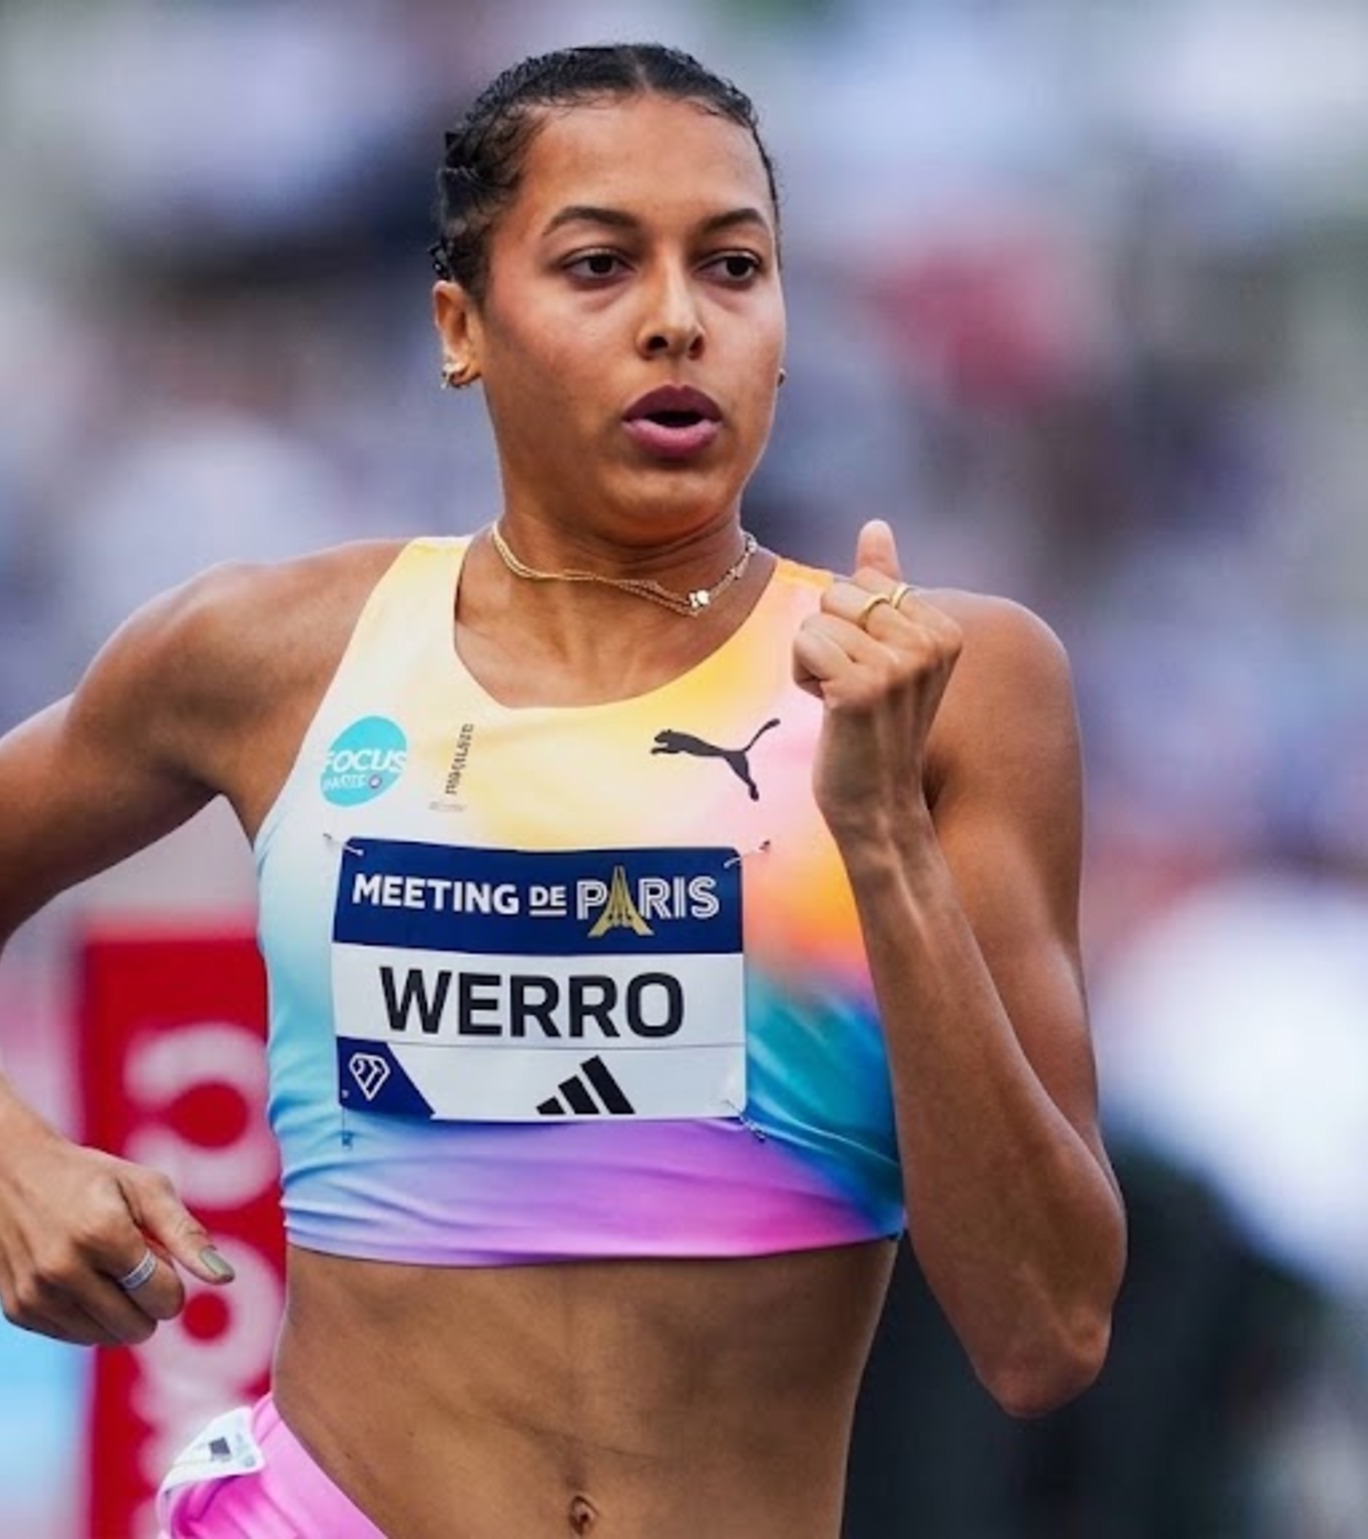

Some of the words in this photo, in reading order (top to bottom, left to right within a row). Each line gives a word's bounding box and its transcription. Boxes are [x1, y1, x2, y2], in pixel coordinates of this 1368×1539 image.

[325, 747, 408, 775] FOCUS
[352, 872, 520, 916] MEETING
[530, 886, 567, 912] DE
[576, 866, 721, 937] PARIS
[379, 966, 685, 1039] WERRO
